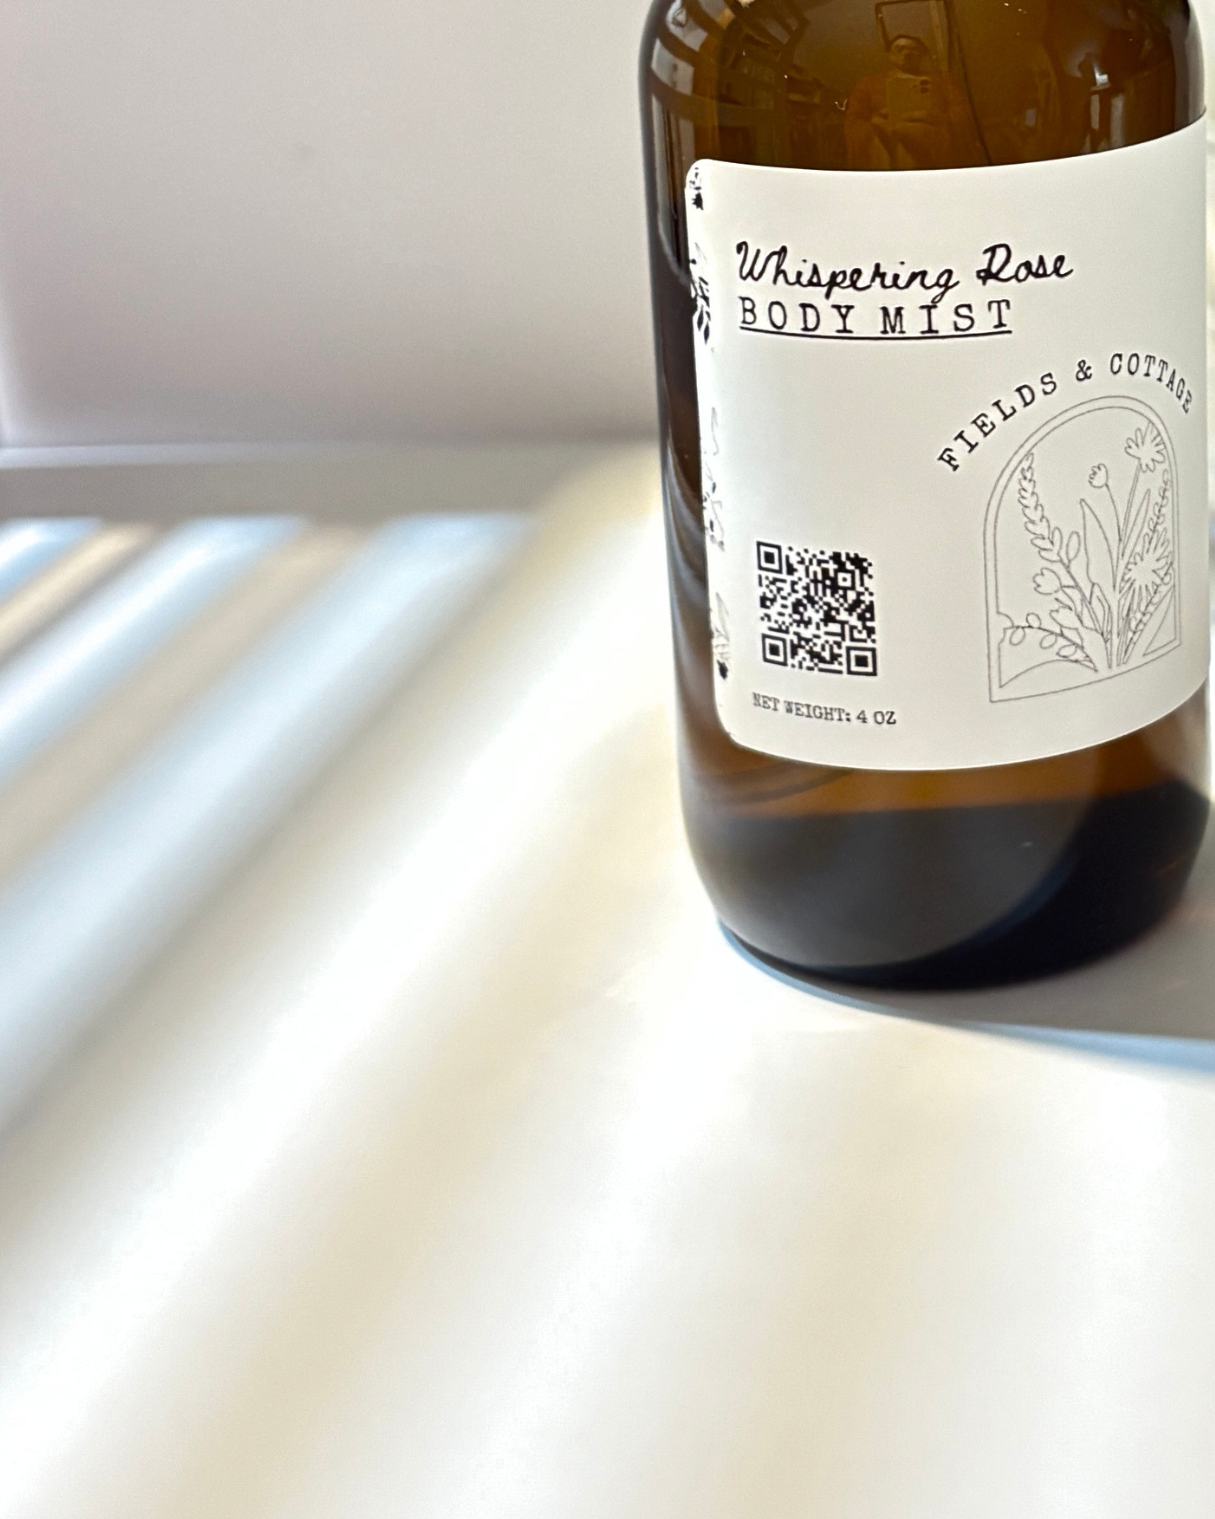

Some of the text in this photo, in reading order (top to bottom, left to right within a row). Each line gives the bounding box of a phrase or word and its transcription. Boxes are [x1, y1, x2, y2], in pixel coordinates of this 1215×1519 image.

[736, 240, 1074, 305] Whispering Rose
[738, 296, 1011, 335] BODY MIST
[937, 352, 1194, 472] FIELDS & COTTAGE
[752, 691, 897, 726] NET WEIGHT: 4 OZ
